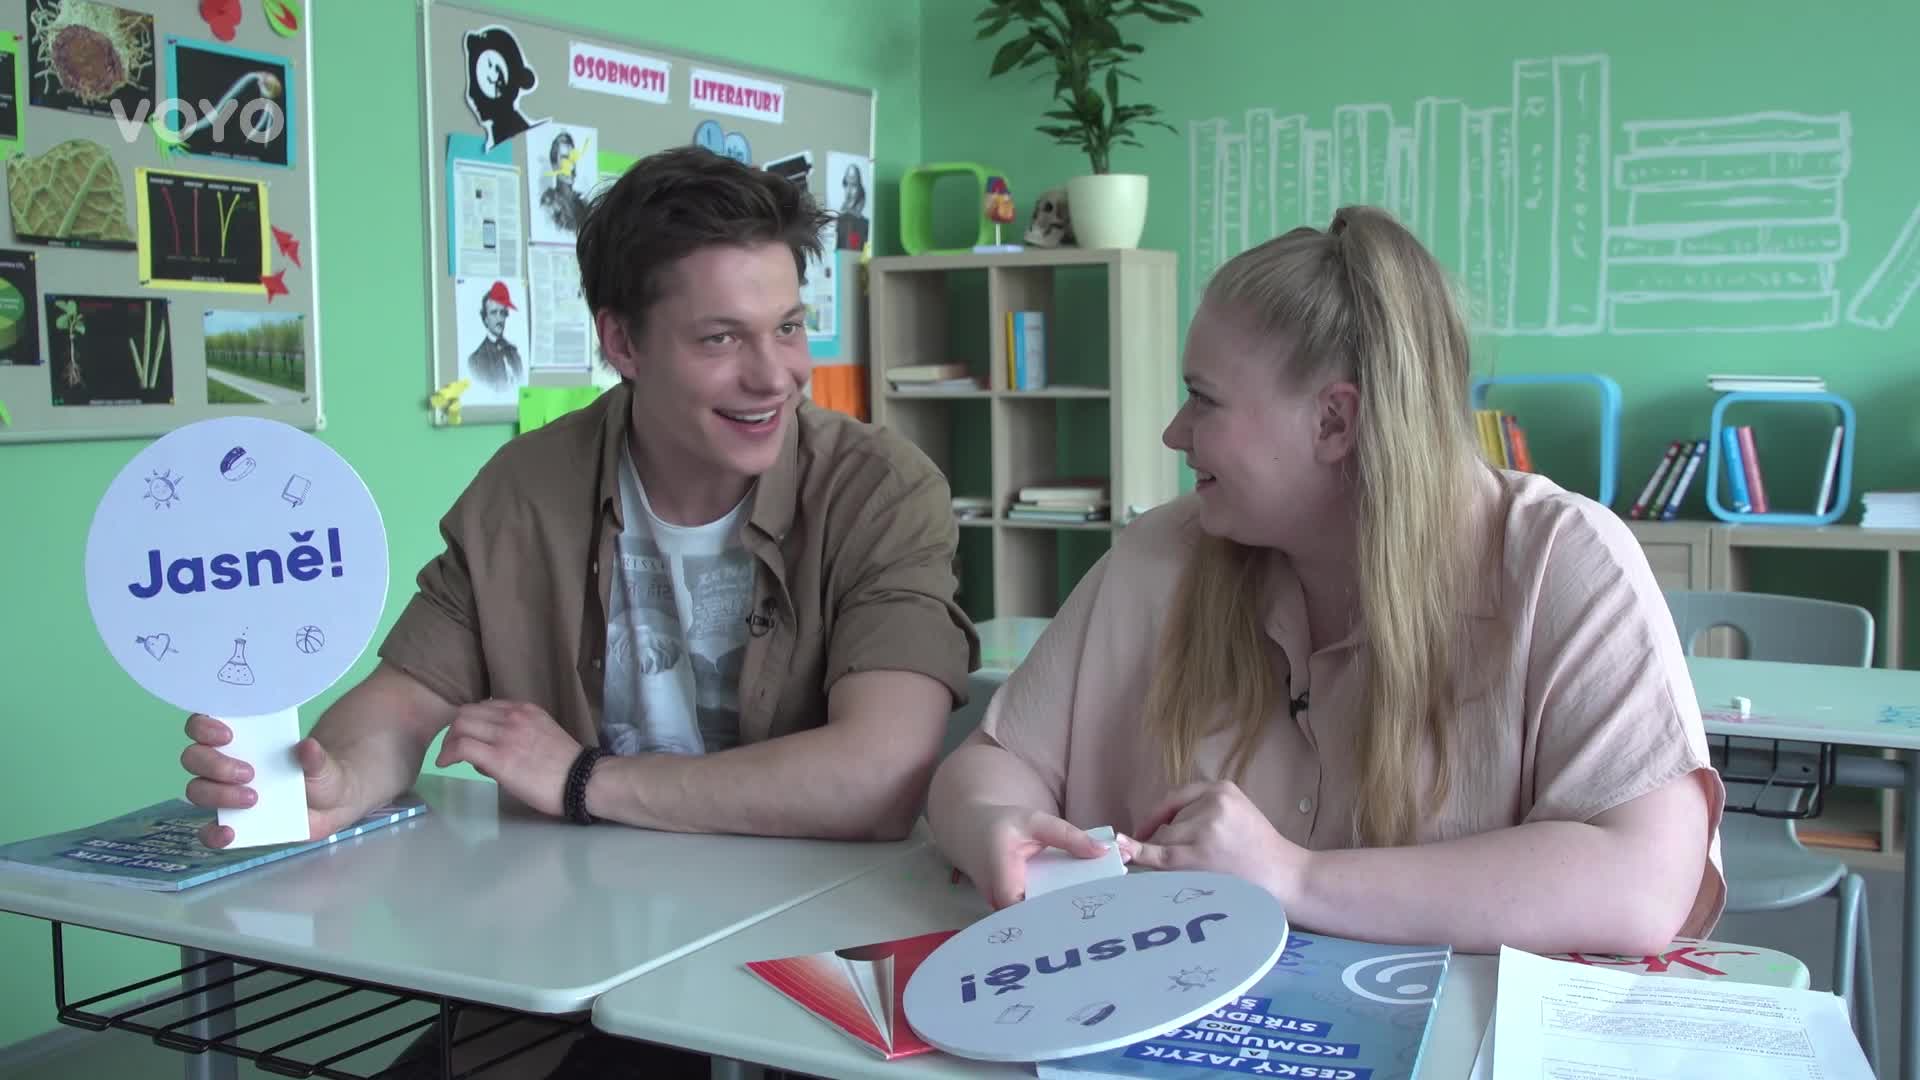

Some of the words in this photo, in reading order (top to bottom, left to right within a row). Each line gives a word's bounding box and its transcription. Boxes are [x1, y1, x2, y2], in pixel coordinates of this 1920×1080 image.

[574, 53, 665, 93] OSOBNOSTI
[694, 79, 781, 112] LITERATURY
[128, 528, 343, 599] Jasně!
[960, 913, 1229, 1003] Jasně!
[1206, 1022, 1243, 1033] PRO
[1212, 1009, 1317, 1032] STŘEDN
[1141, 1046, 1246, 1068] JAZYK
[1163, 1028, 1344, 1056] KOMUNIKA
